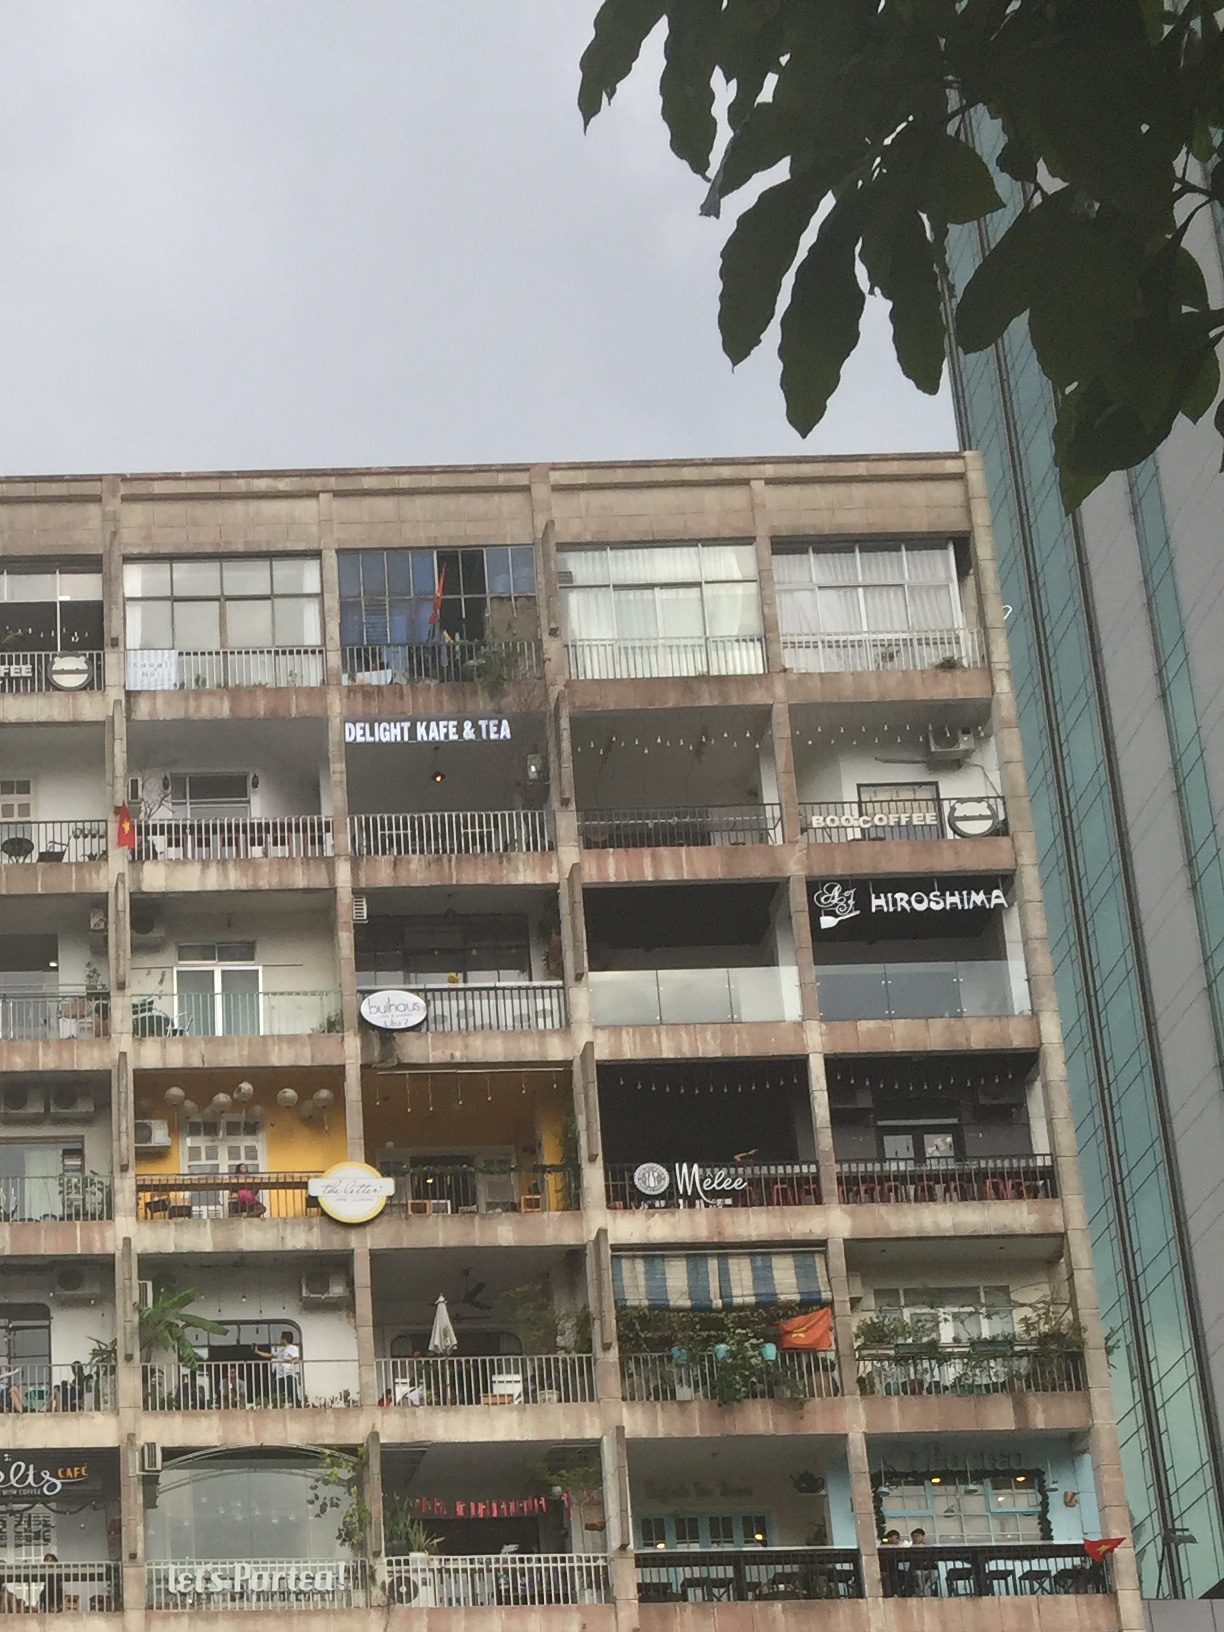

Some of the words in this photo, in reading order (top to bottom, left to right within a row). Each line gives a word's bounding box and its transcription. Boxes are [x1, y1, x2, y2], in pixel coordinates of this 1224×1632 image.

[344, 722, 410, 743] DELIGHT
[416, 721, 458, 742] KAFE
[463, 720, 475, 740] &
[478, 719, 511, 740] TEA
[812, 815, 854, 828] BOO
[859, 812, 937, 828] COFFEE
[871, 889, 1008, 914] HIROSHIMA
